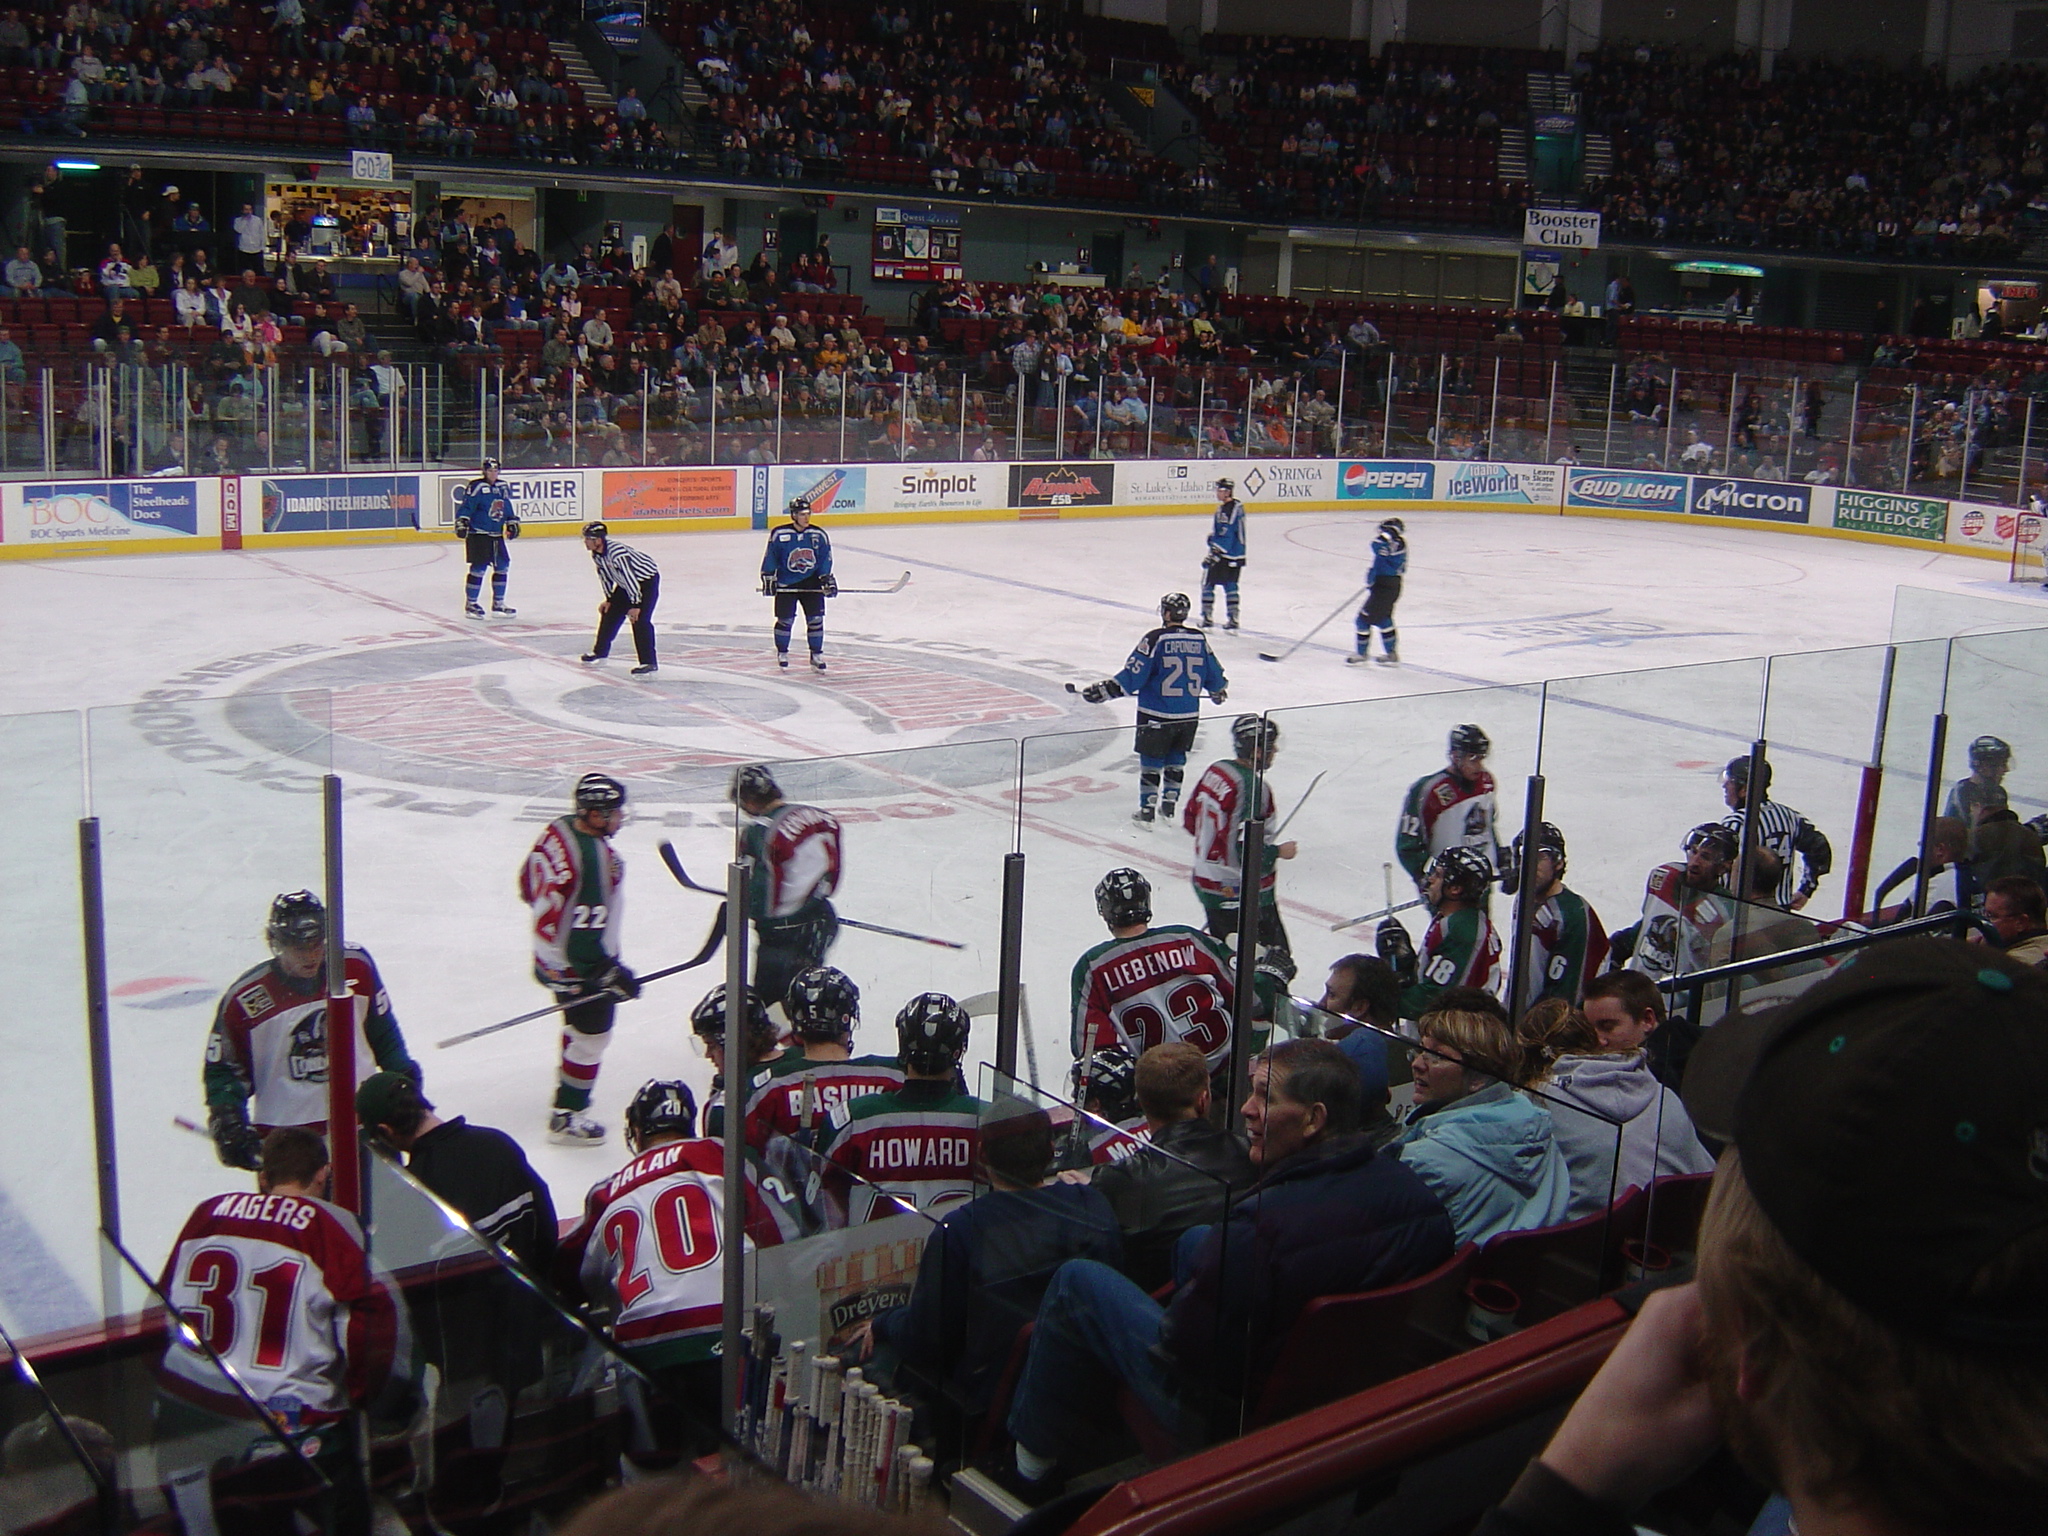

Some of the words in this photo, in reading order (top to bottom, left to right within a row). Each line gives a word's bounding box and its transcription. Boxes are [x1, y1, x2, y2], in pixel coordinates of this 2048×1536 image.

[902, 212, 925, 222] Qwest
[1528, 211, 1598, 229] Booster
[1540, 229, 1582, 246] Club
[2001, 286, 2039, 298] INFO
[1268, 465, 1322, 480] SYRINGA
[1364, 471, 1427, 489] PEPSI
[1469, 465, 1499, 476] Idaho
[1532, 468, 1556, 476] Learn
[1532, 475, 1555, 483] Skate
[132, 484, 154, 496] The
[510, 480, 577, 499] EMIER
[902, 474, 977, 499] Simplot
[1022, 477, 1100, 496] REDHOOK
[1146, 481, 1172, 493] Luke's
[1180, 480, 1204, 492] Idaho
[1277, 483, 1313, 498] BANK
[1448, 473, 1519, 496] IceWorld
[1578, 479, 1622, 497] BUD
[1622, 482, 1683, 501] LIGHT
[132, 496, 190, 508] Steelheads
[224, 481, 238, 531] CCM
[1050, 494, 1072, 505] ESB
[1697, 482, 1803, 513] Micron
[1839, 493, 1920, 514] HIGGINS
[30, 496, 110, 526] BOC
[132, 510, 162, 520] Docs
[632, 506, 730, 517] idahotickets.com
[1838, 507, 1931, 530] RUTLEDGE
[30, 528, 53, 538] BOC
[56, 527, 85, 539] Sports
[88, 525, 131, 536] Medicine
[1125, 656, 1145, 675] 25
[1161, 655, 1205, 697] 25
[1402, 815, 1419, 837] 12
[572, 904, 609, 929] 22
[1103, 944, 1197, 992] LIEBENOW
[1424, 954, 1457, 986] 18
[1549, 954, 1568, 981] 6
[1119, 979, 1232, 1062] 23
[868, 1137, 970, 1169] HOWARD
[211, 1194, 317, 1231] MAGERS
[603, 1180, 723, 1310] 20
[178, 1244, 307, 1372] 31
